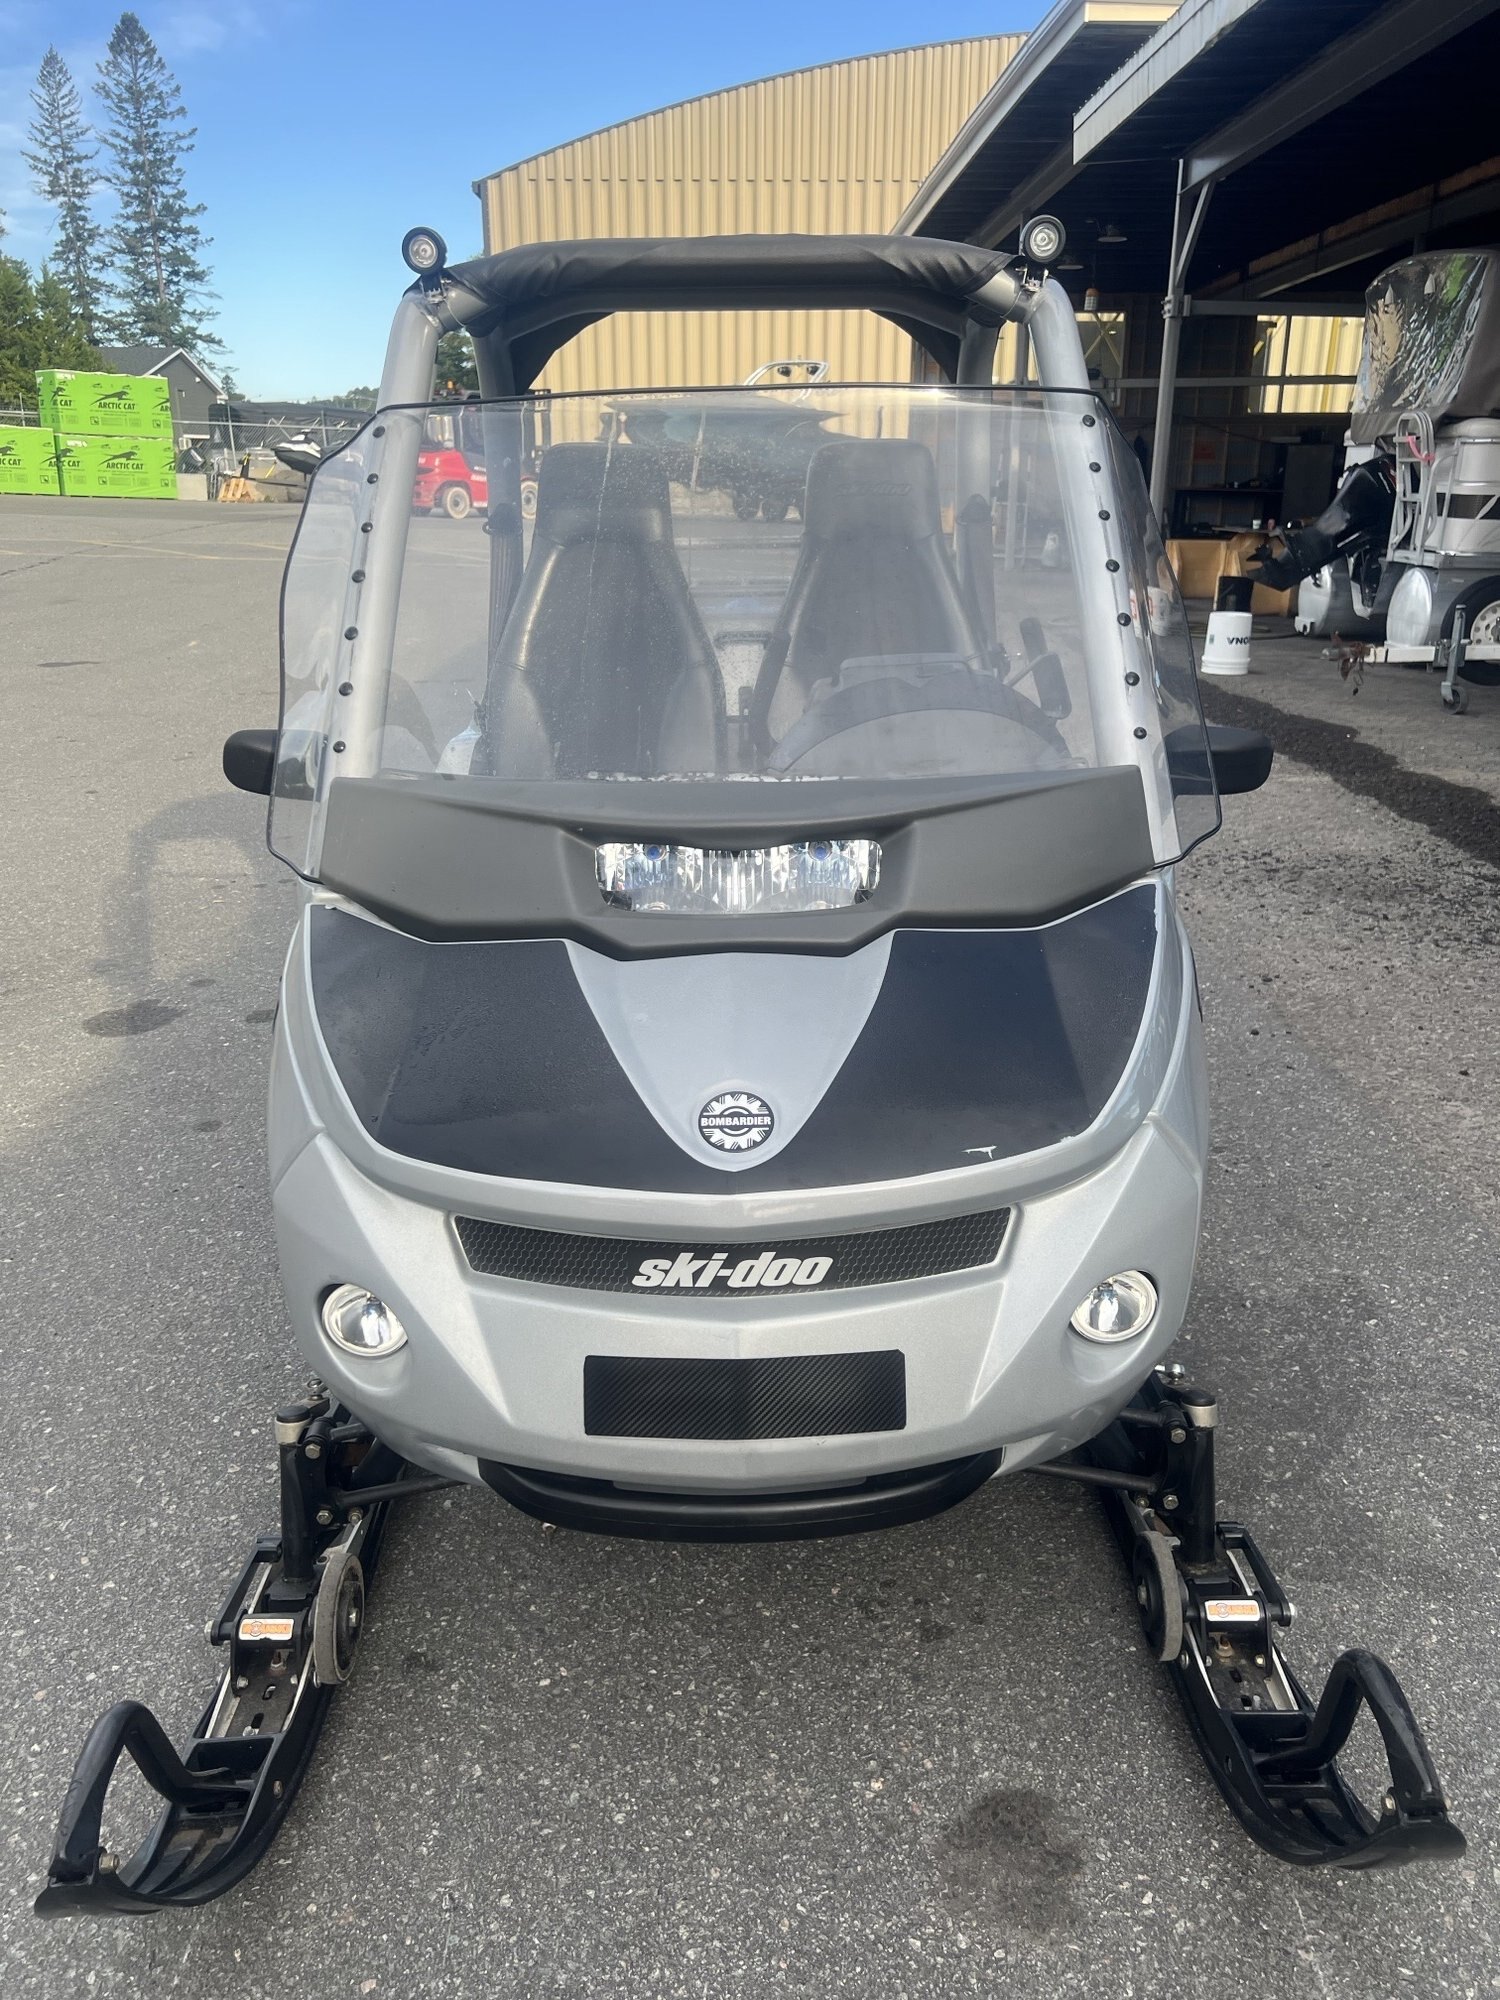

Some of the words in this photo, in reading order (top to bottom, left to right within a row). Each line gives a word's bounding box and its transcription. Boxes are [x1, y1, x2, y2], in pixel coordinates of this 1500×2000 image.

[98, 402, 121, 410] ARCTIC
[123, 403, 136, 411] CAT
[8, 458, 21, 466] CAT
[106, 462, 130, 470] ARCTIC
[700, 1116, 772, 1127] BOMBARDIER
[631, 1251, 834, 1288] ski-doo
